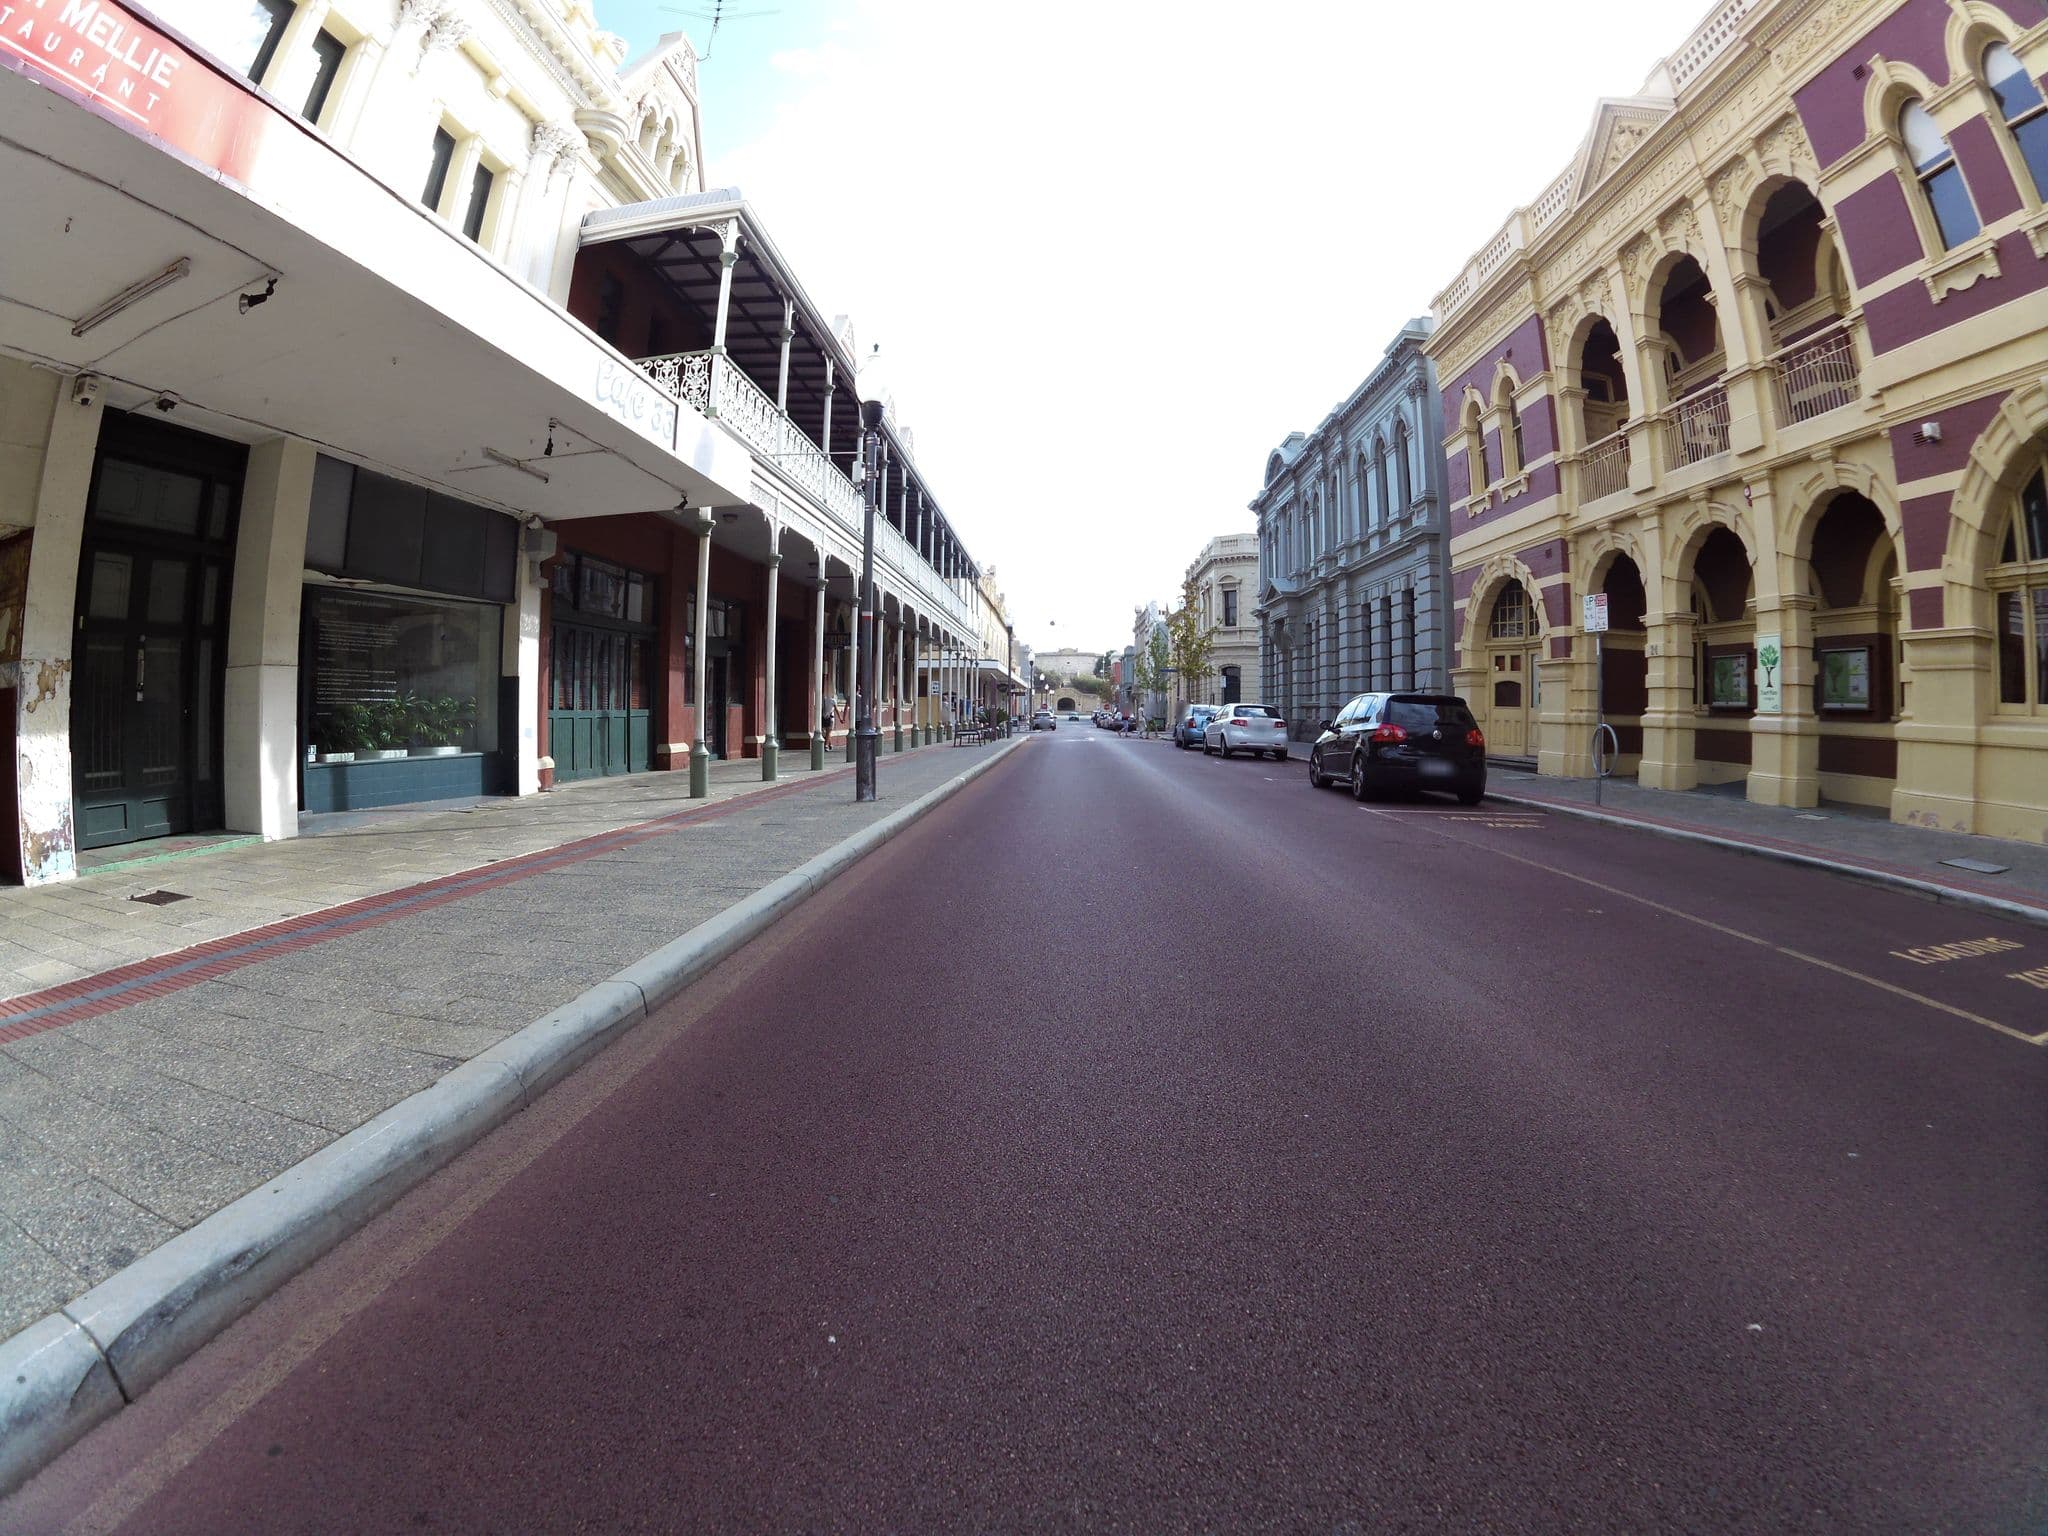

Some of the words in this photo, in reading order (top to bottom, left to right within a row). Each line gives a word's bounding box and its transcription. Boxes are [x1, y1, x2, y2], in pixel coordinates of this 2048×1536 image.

[60, 0, 180, 88] MELLIE
[1543, 237, 1596, 290] HOTEL
[1601, 149, 1692, 236] CLEOPATRA
[1702, 76, 1779, 152] HOTEL
